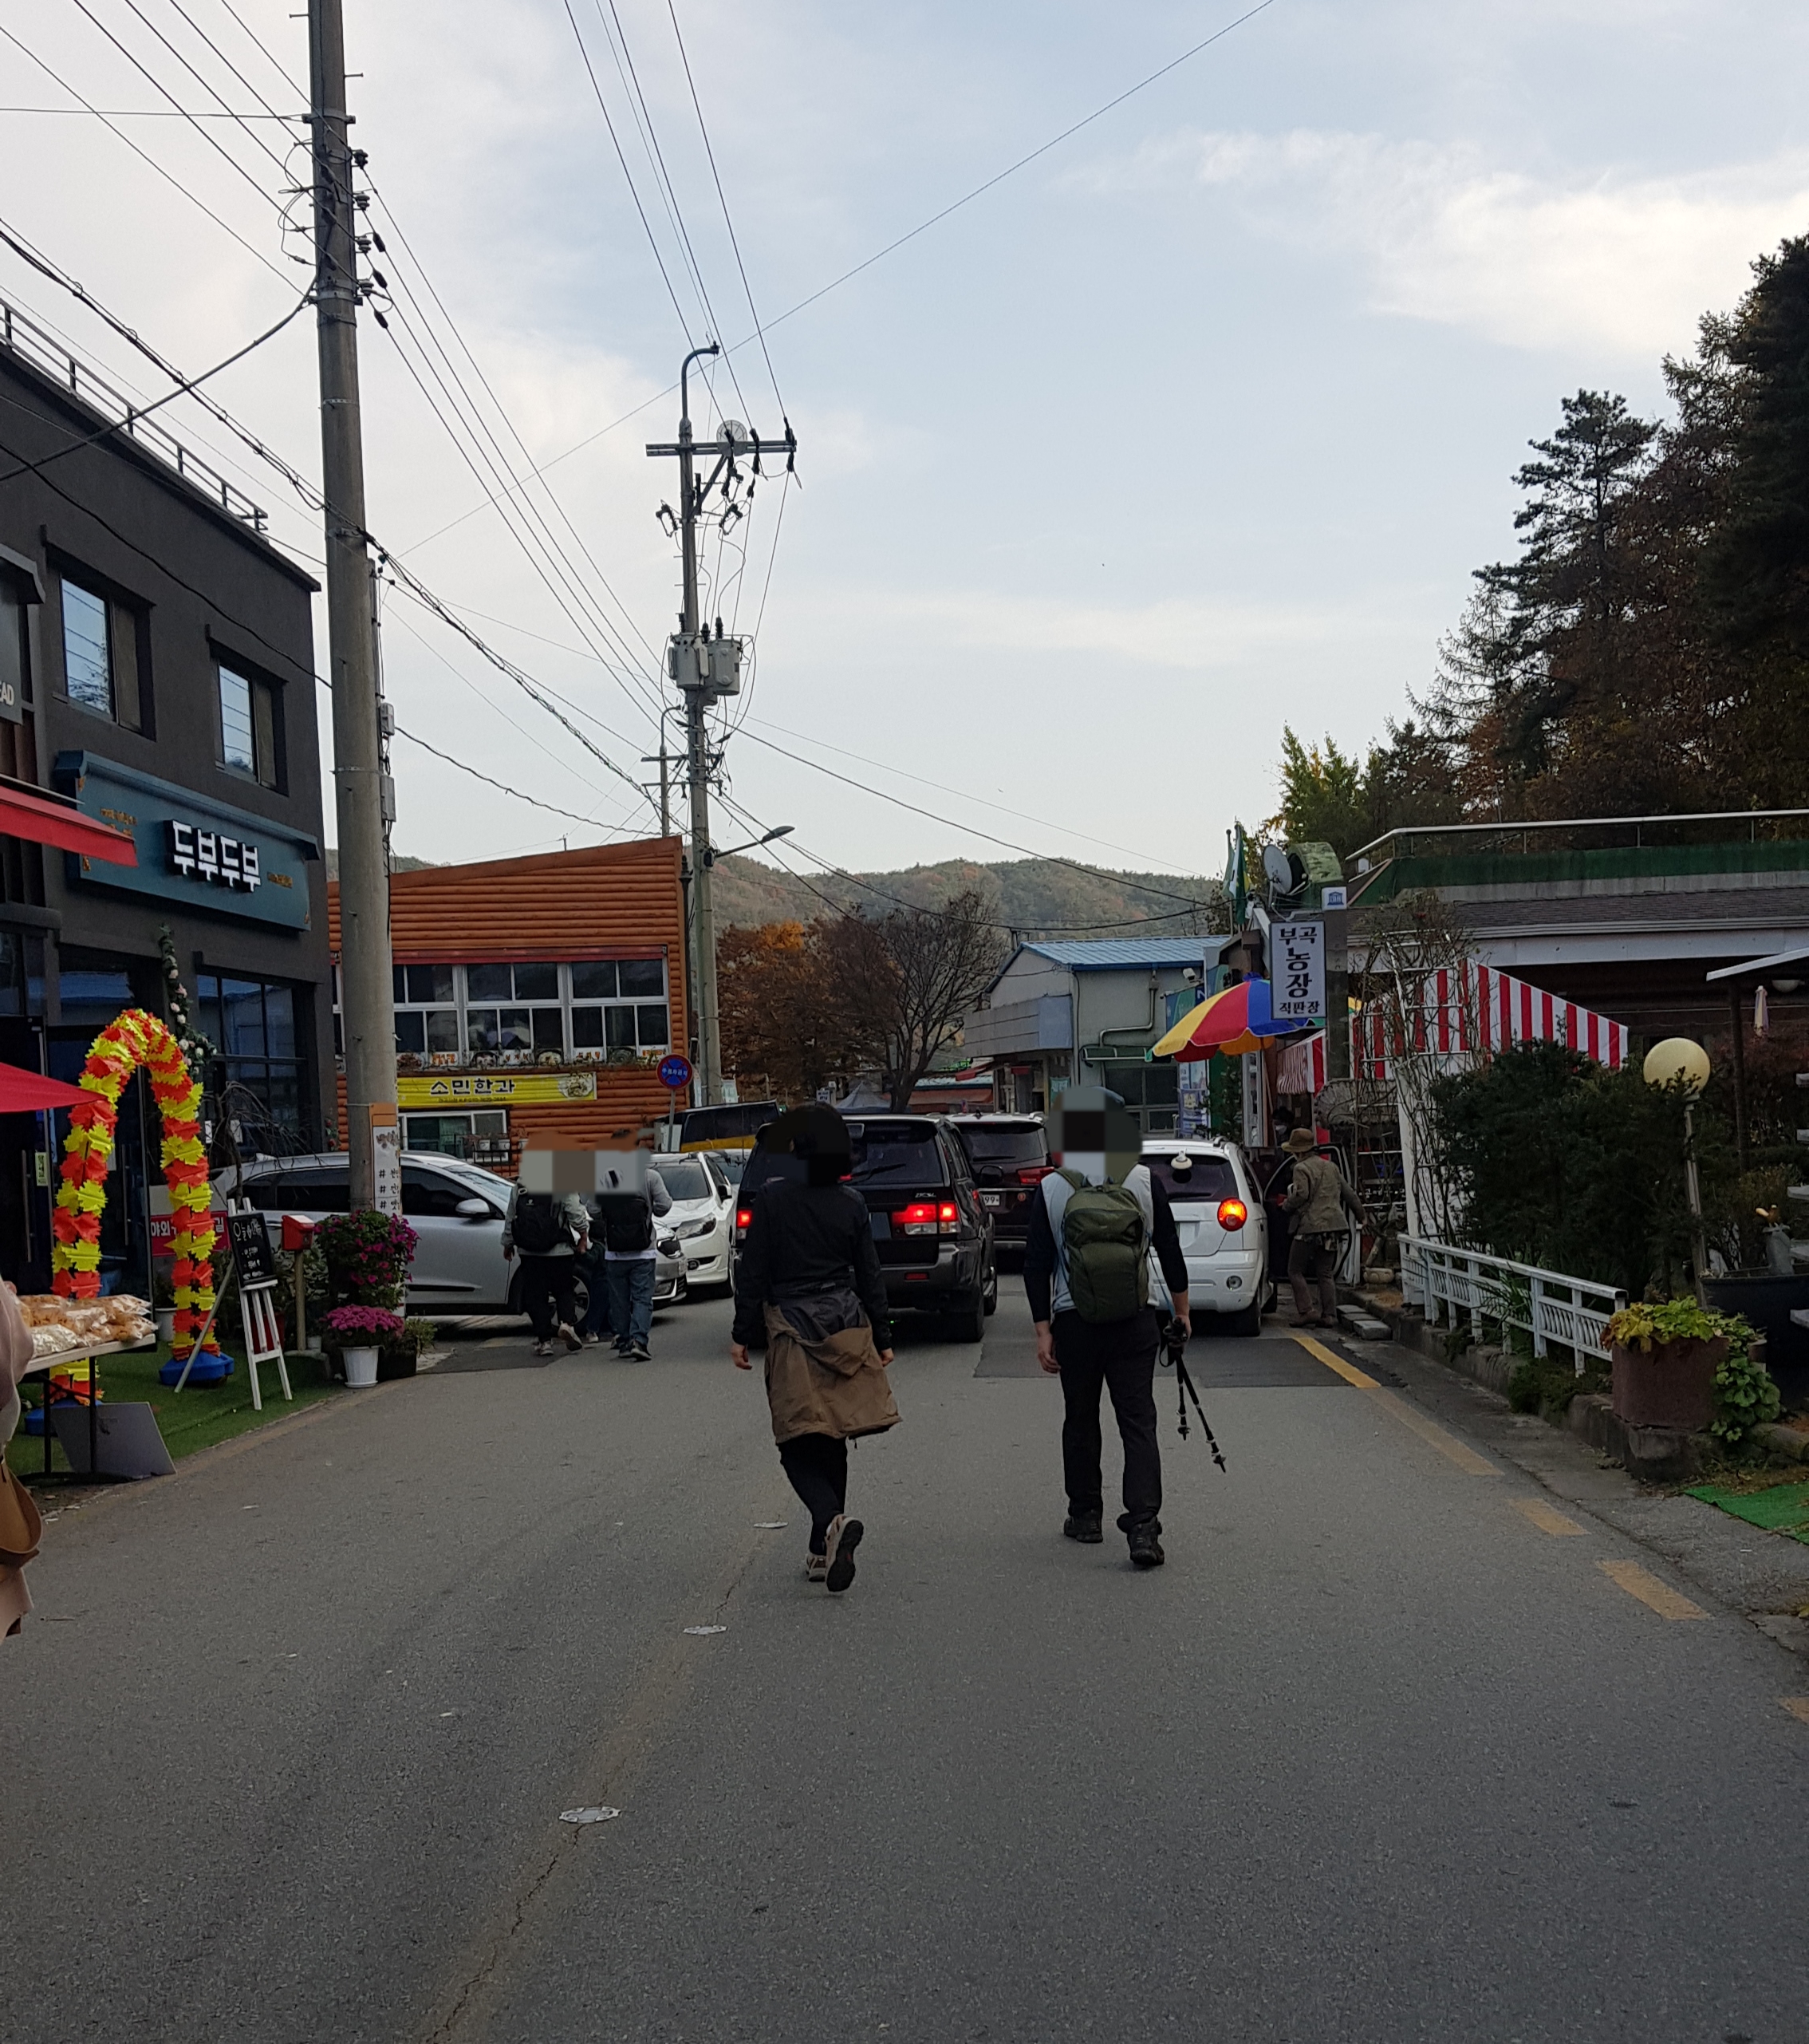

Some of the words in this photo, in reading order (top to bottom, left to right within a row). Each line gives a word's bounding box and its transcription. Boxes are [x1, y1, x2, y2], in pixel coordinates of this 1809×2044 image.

[0, 680, 14, 706] AD
[172, 819, 262, 893] 두부두부
[1279, 926, 1318, 946] 부곡
[1279, 1000, 1320, 1015] 직판장
[430, 1078, 515, 1095] 소민한과
